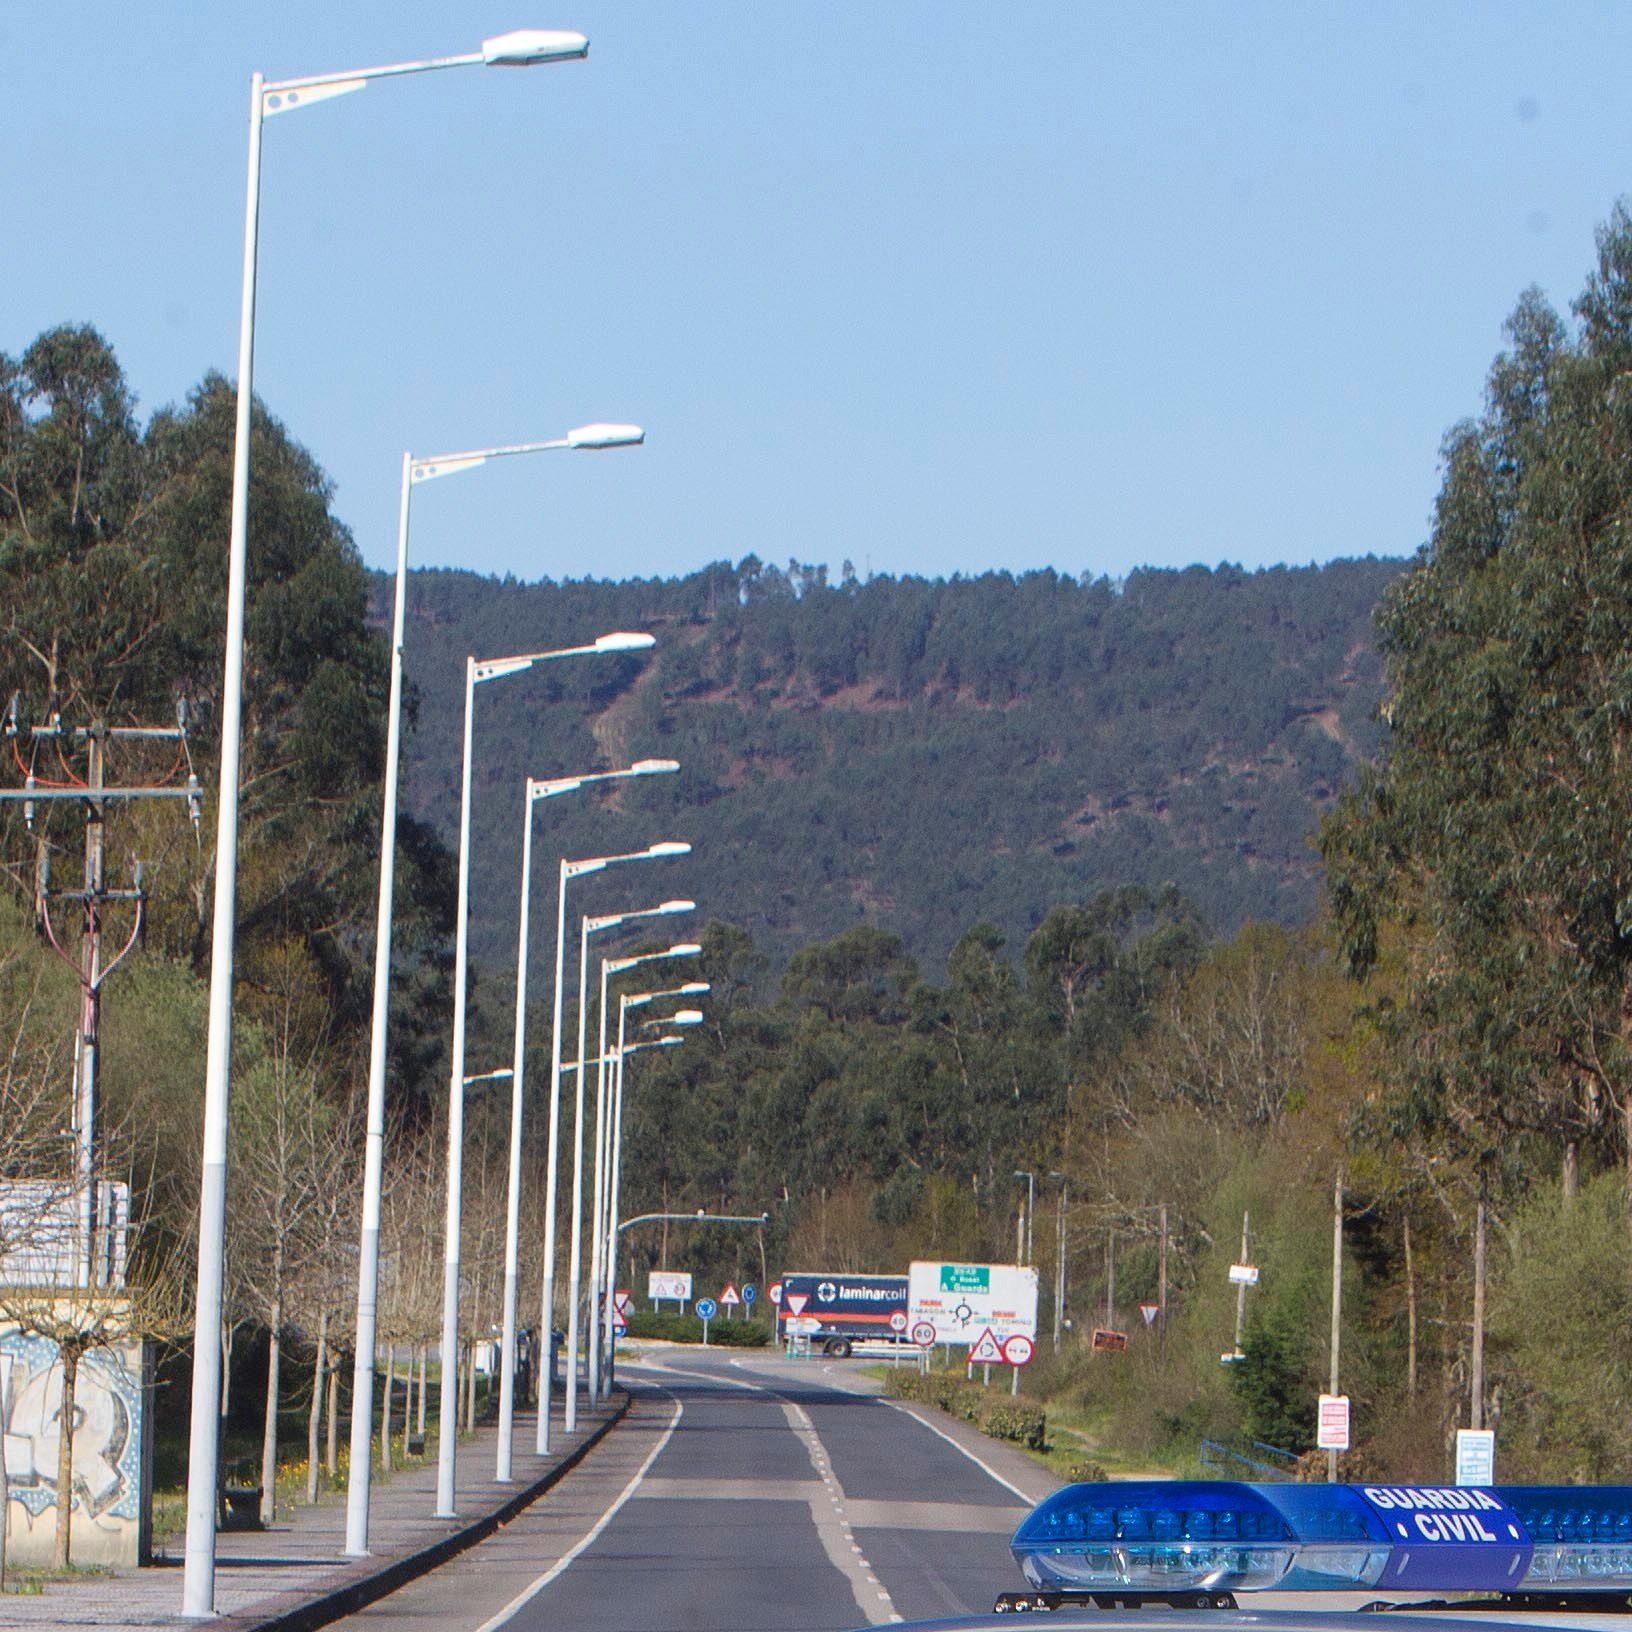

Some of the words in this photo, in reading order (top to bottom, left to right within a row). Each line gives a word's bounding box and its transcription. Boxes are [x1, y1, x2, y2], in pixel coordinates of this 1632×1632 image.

[839, 1286, 906, 1301] laminarcoil
[892, 1316, 904, 1325] 40
[916, 1329, 931, 1338] 60
[1364, 1487, 1502, 1511] GUARDIA
[1414, 1513, 1497, 1542] CIVIL
